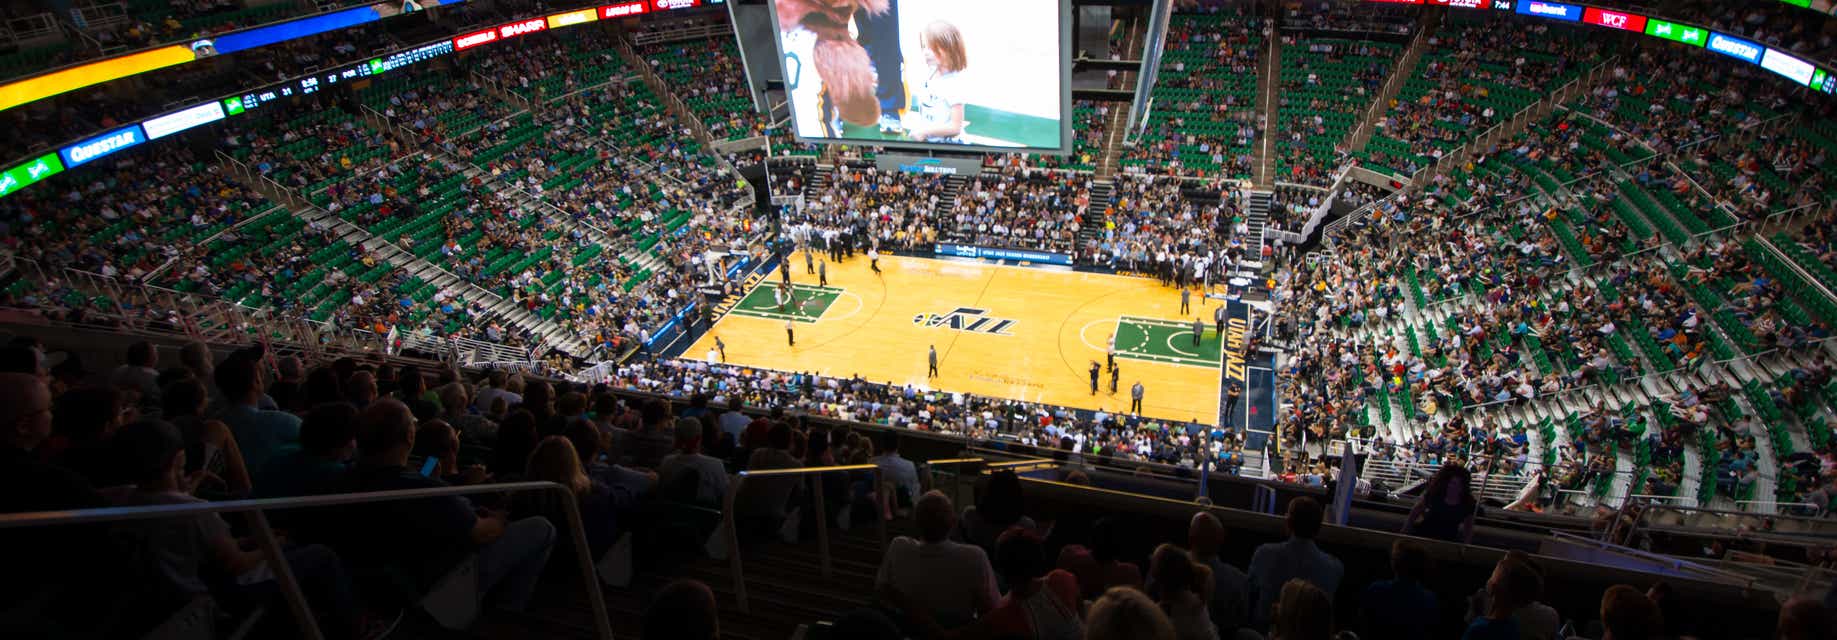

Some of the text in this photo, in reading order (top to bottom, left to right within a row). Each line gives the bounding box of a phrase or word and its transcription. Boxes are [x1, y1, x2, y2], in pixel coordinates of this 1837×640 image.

[1602, 12, 1627, 27] WCF
[501, 19, 545, 38] SHARP
[259, 91, 276, 102] UTA
